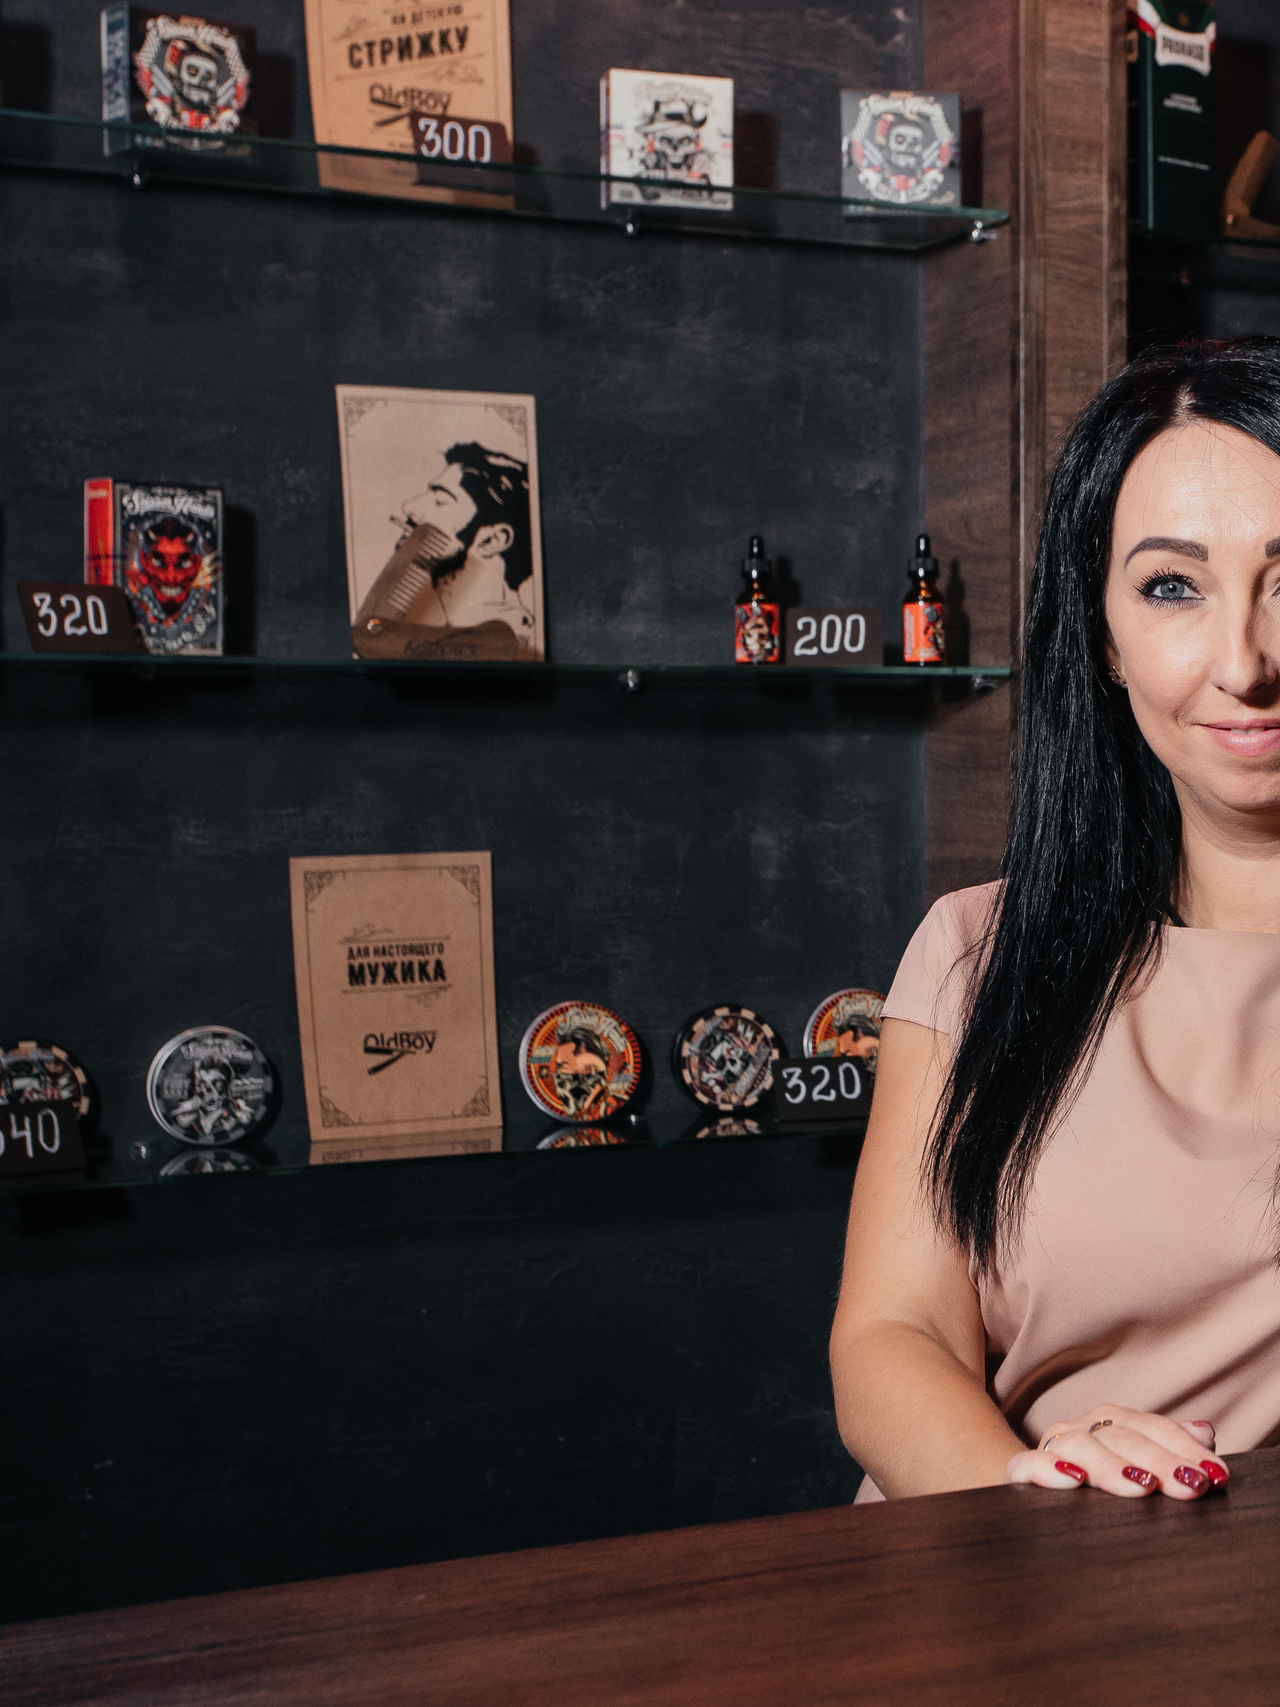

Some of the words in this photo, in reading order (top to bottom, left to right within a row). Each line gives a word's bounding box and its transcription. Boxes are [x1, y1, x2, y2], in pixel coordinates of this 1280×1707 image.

[347, 25, 469, 69] СТРИЖКУ
[418, 117, 492, 163] 300
[33, 592, 108, 637] 320
[793, 613, 866, 656] 200
[347, 959, 446, 987] МУЖИКА
[348, 945, 370, 960] ДЛЯ
[372, 942, 444, 958] НАСТОЯЩЕГО
[782, 1061, 862, 1105] 320
[0, 1107, 60, 1159] 40
